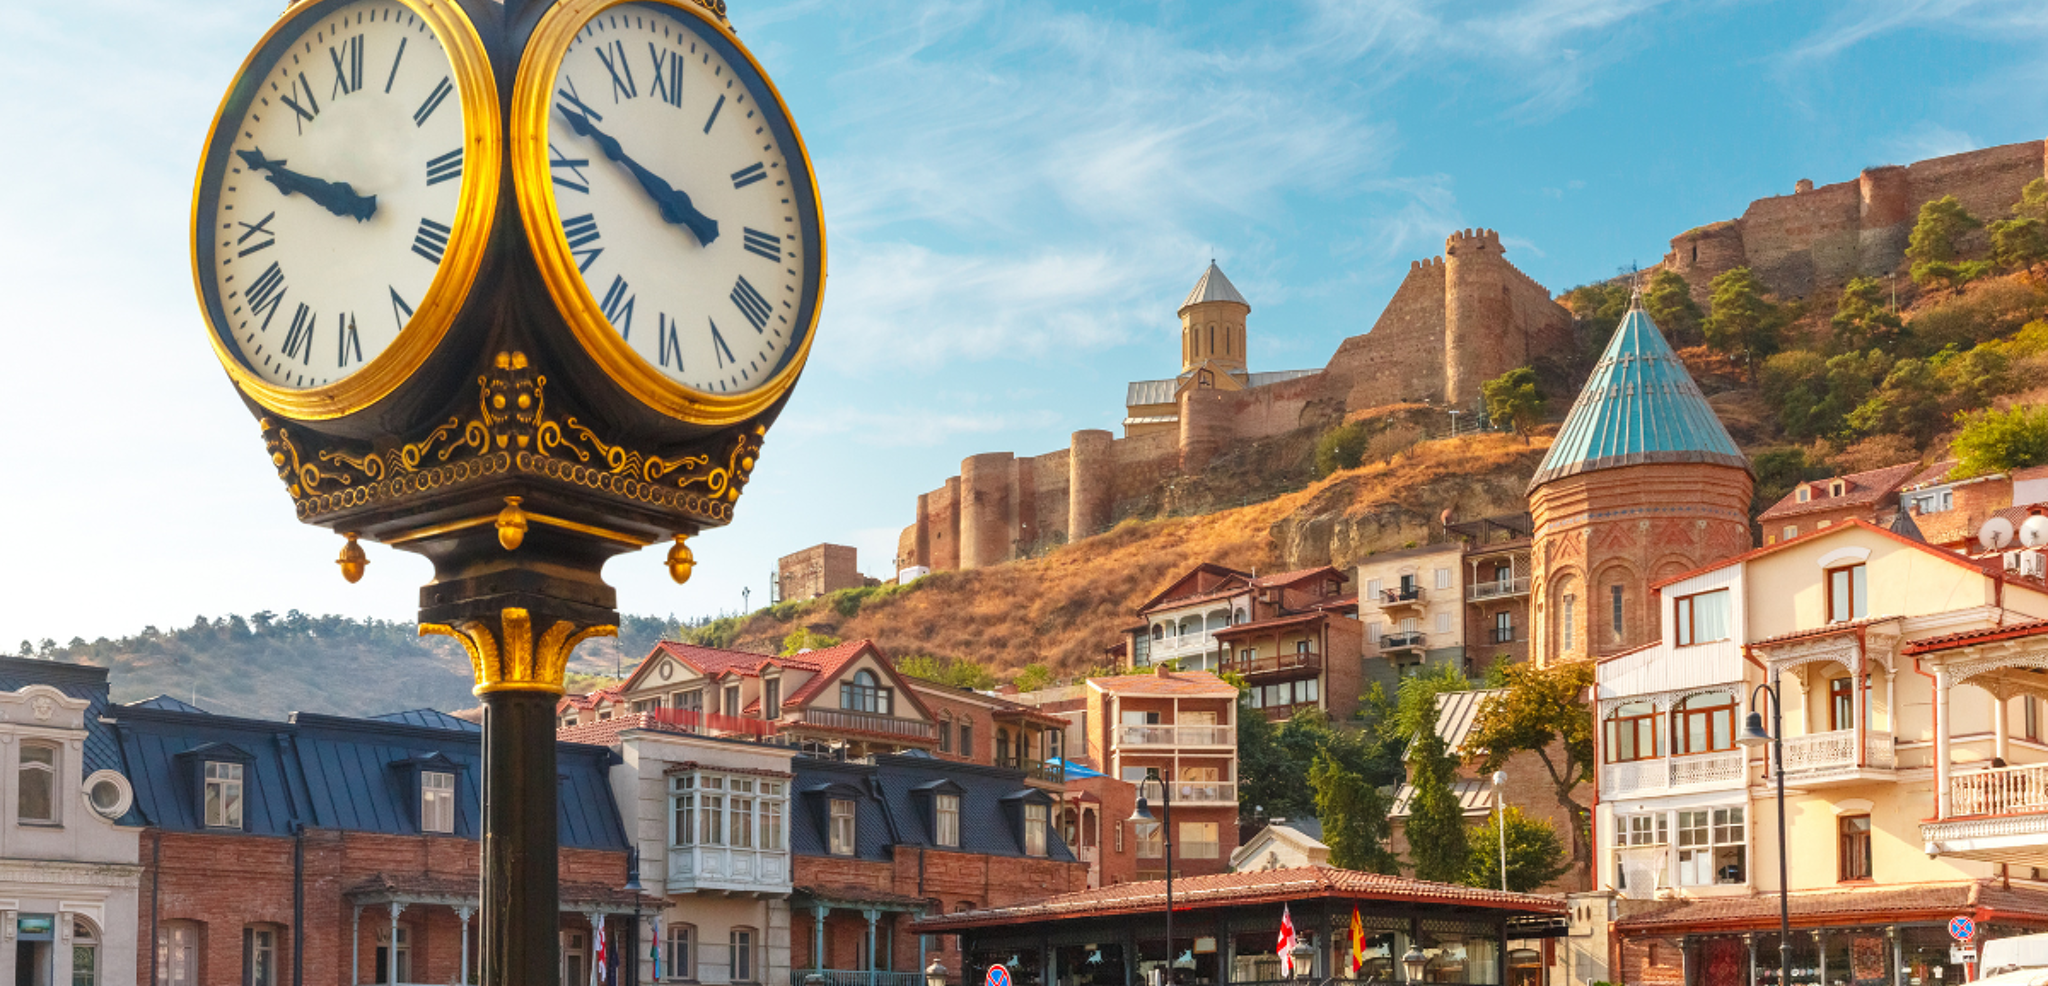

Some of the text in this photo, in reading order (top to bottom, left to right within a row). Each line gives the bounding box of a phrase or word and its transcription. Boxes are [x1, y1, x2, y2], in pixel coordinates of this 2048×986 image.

[329, 34, 364, 101] XII
[384, 37, 407, 94] I
[594, 39, 637, 104] XI
[648, 42, 684, 109] XII
[280, 71, 320, 136] XI
[413, 75, 453, 128] II
[703, 94, 726, 134] I
[426, 147, 464, 187] III
[549, 143, 589, 195] IX
[730, 161, 768, 189] II
[238, 211, 275, 258] IX
[743, 226, 781, 263] III
[338, 311, 362, 368] VI
[659, 311, 684, 372] VI
